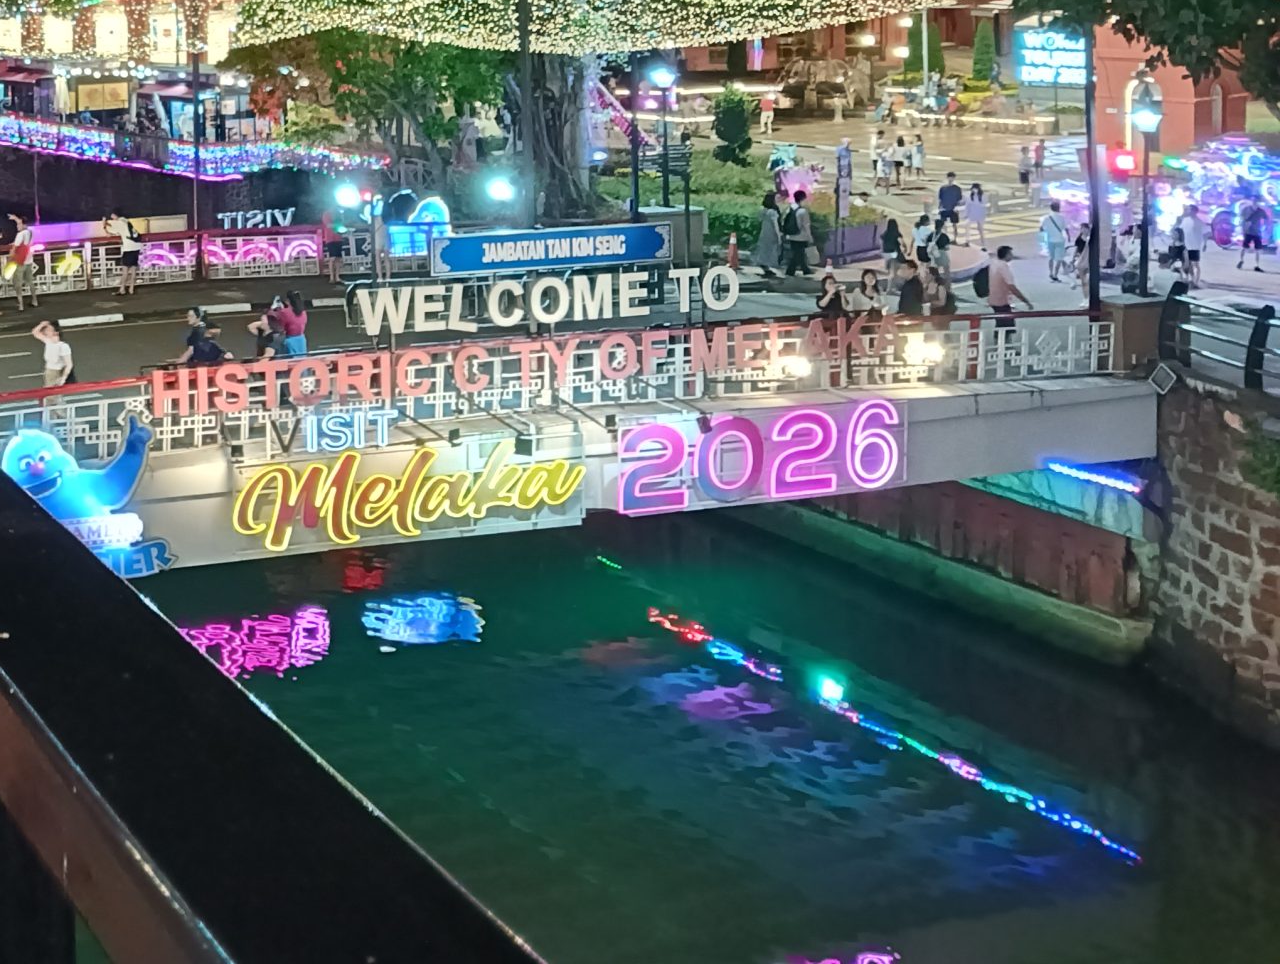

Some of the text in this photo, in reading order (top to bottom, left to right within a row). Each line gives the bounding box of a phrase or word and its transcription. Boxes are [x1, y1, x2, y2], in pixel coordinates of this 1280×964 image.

[482, 235, 626, 263] JAMBATAN TAN KIM SENG
[356, 265, 740, 336] WELCOME TO
[152, 350, 432, 418] HISTORIC
[453, 337, 581, 393] CTY
[599, 330, 670, 380] OF
[270, 410, 398, 455] VISIT
[232, 399, 899, 552] Melaka 2026
